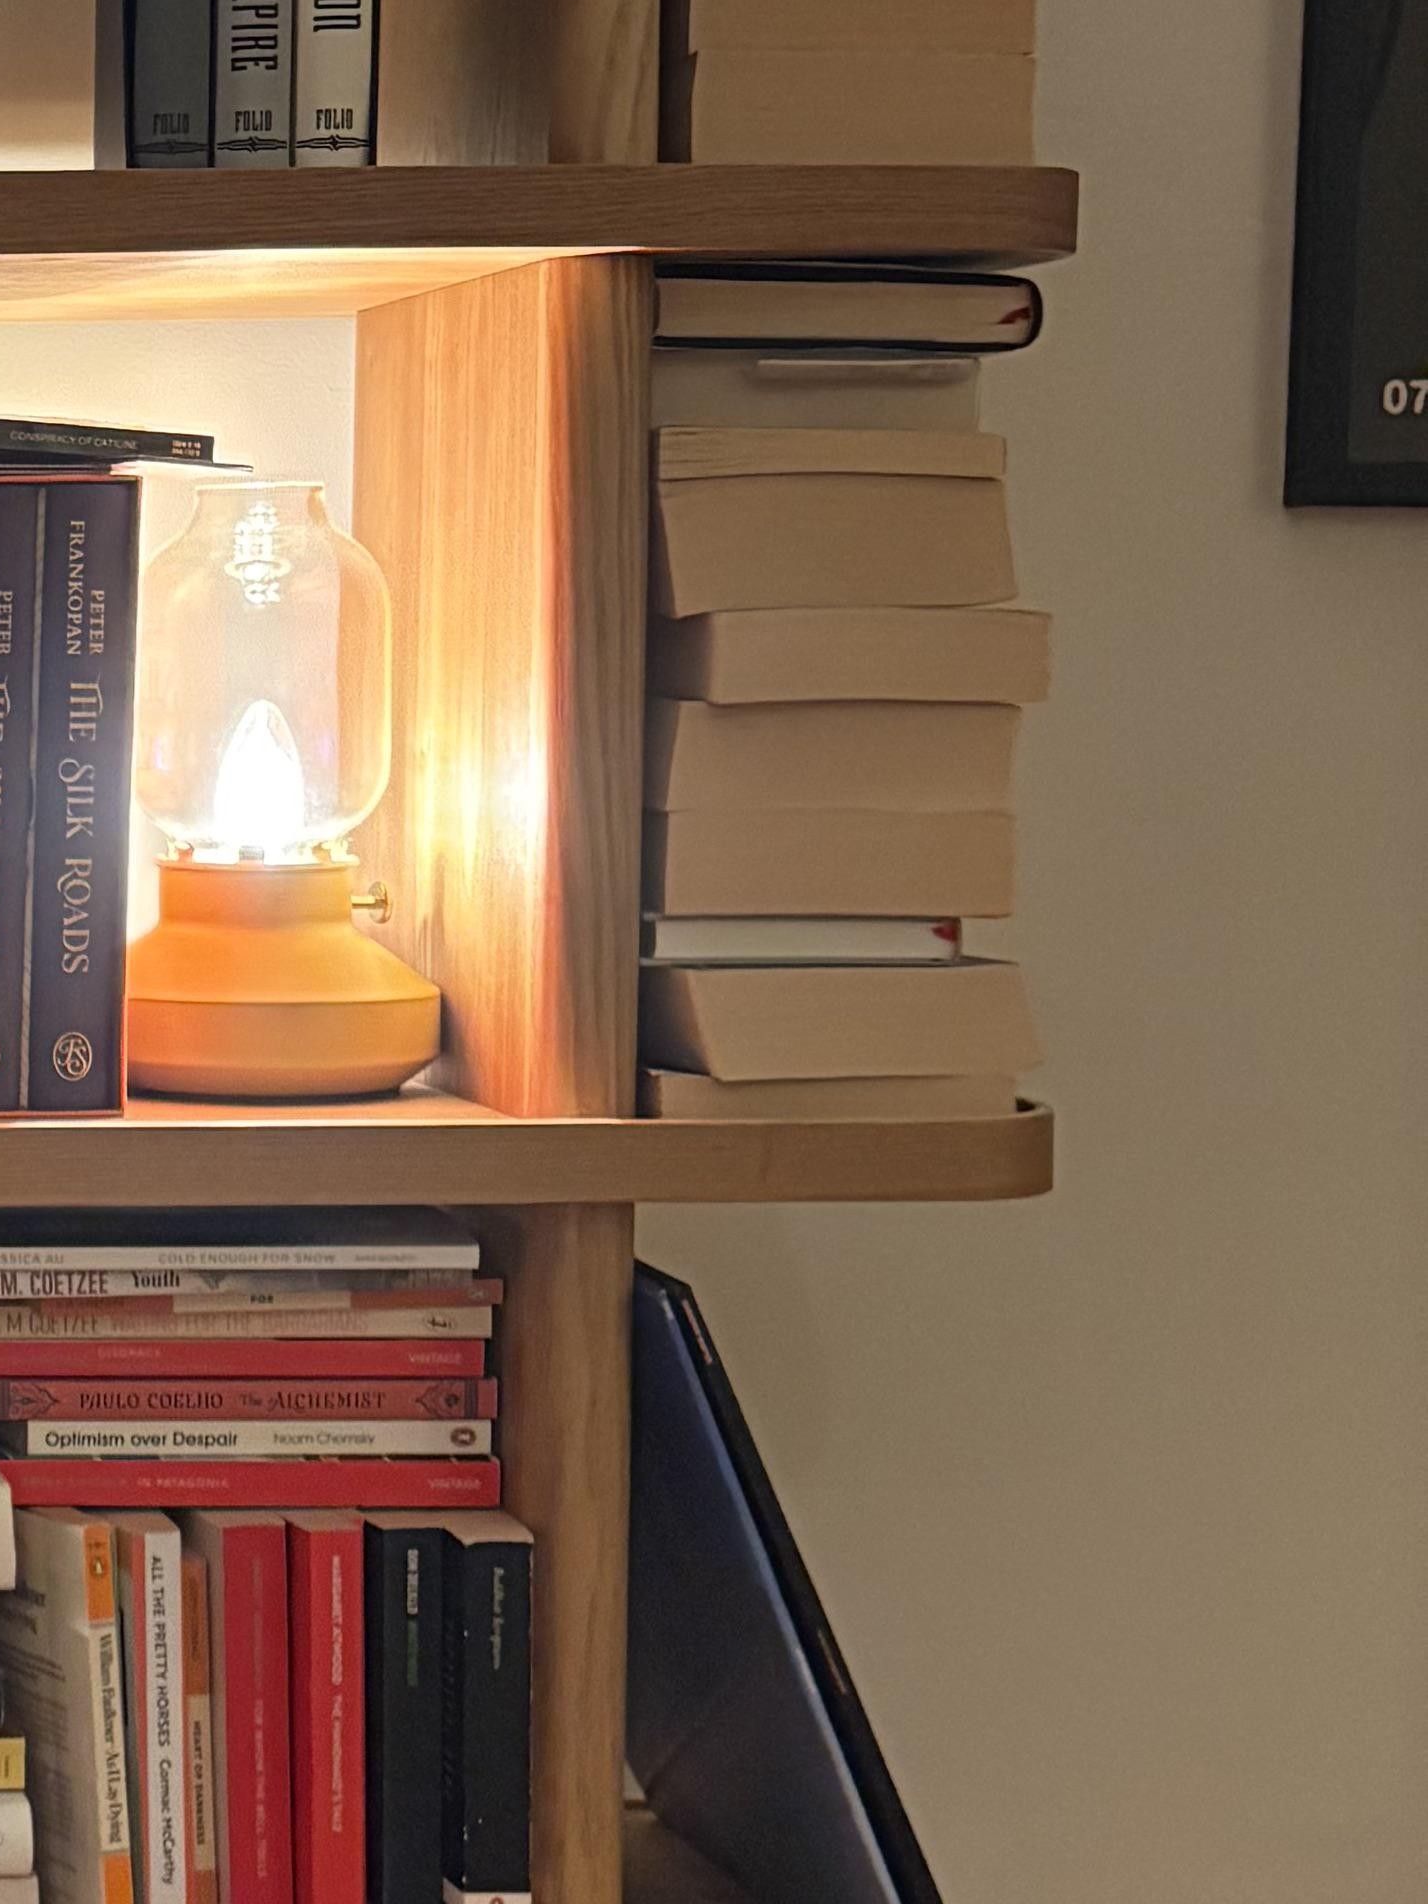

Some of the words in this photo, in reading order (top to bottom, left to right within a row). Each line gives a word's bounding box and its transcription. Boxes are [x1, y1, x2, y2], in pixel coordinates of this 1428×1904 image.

[45, 1431, 124, 1451] Optimism
[131, 1434, 167, 1447] over
[173, 1431, 238, 1451] Despair
